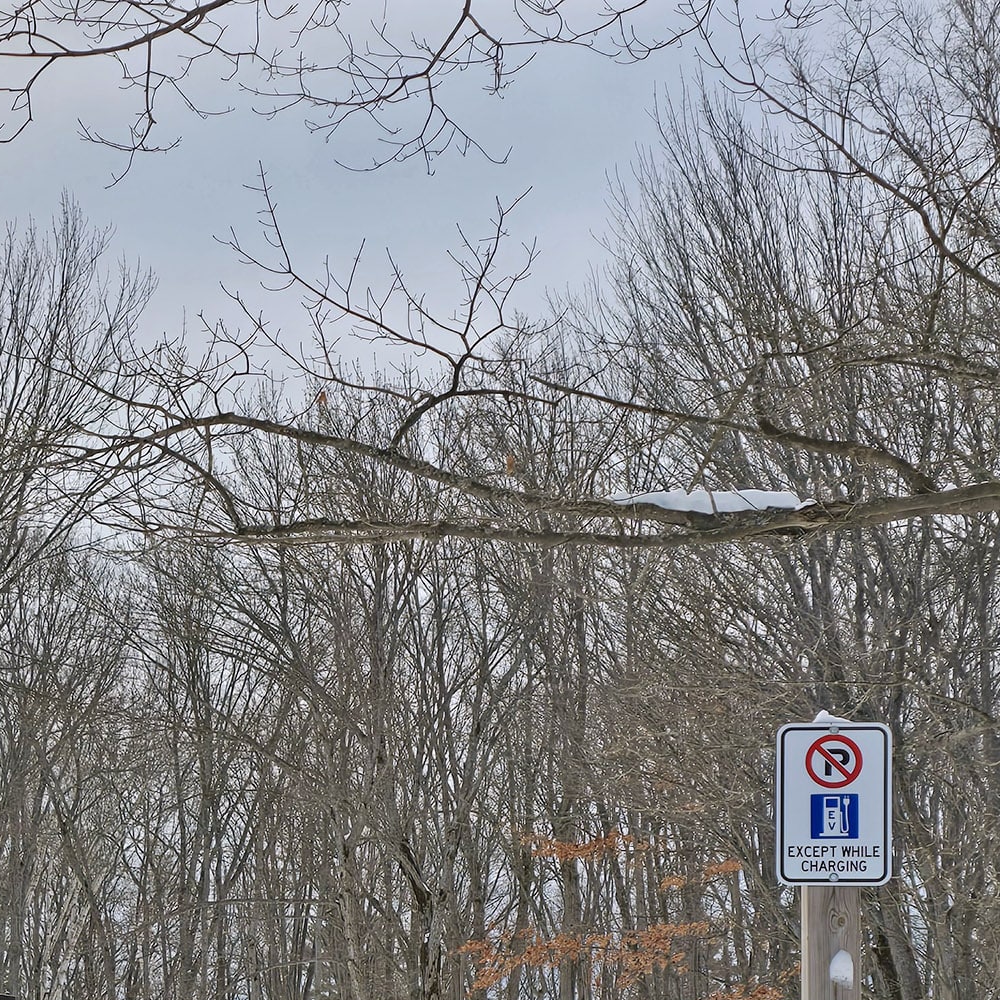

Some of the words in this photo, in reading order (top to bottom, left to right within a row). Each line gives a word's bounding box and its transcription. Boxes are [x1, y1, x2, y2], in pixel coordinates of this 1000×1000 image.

[788, 846, 837, 858] EXCEPT
[841, 845, 880, 858] WHILE
[801, 860, 867, 873] CHARGING
